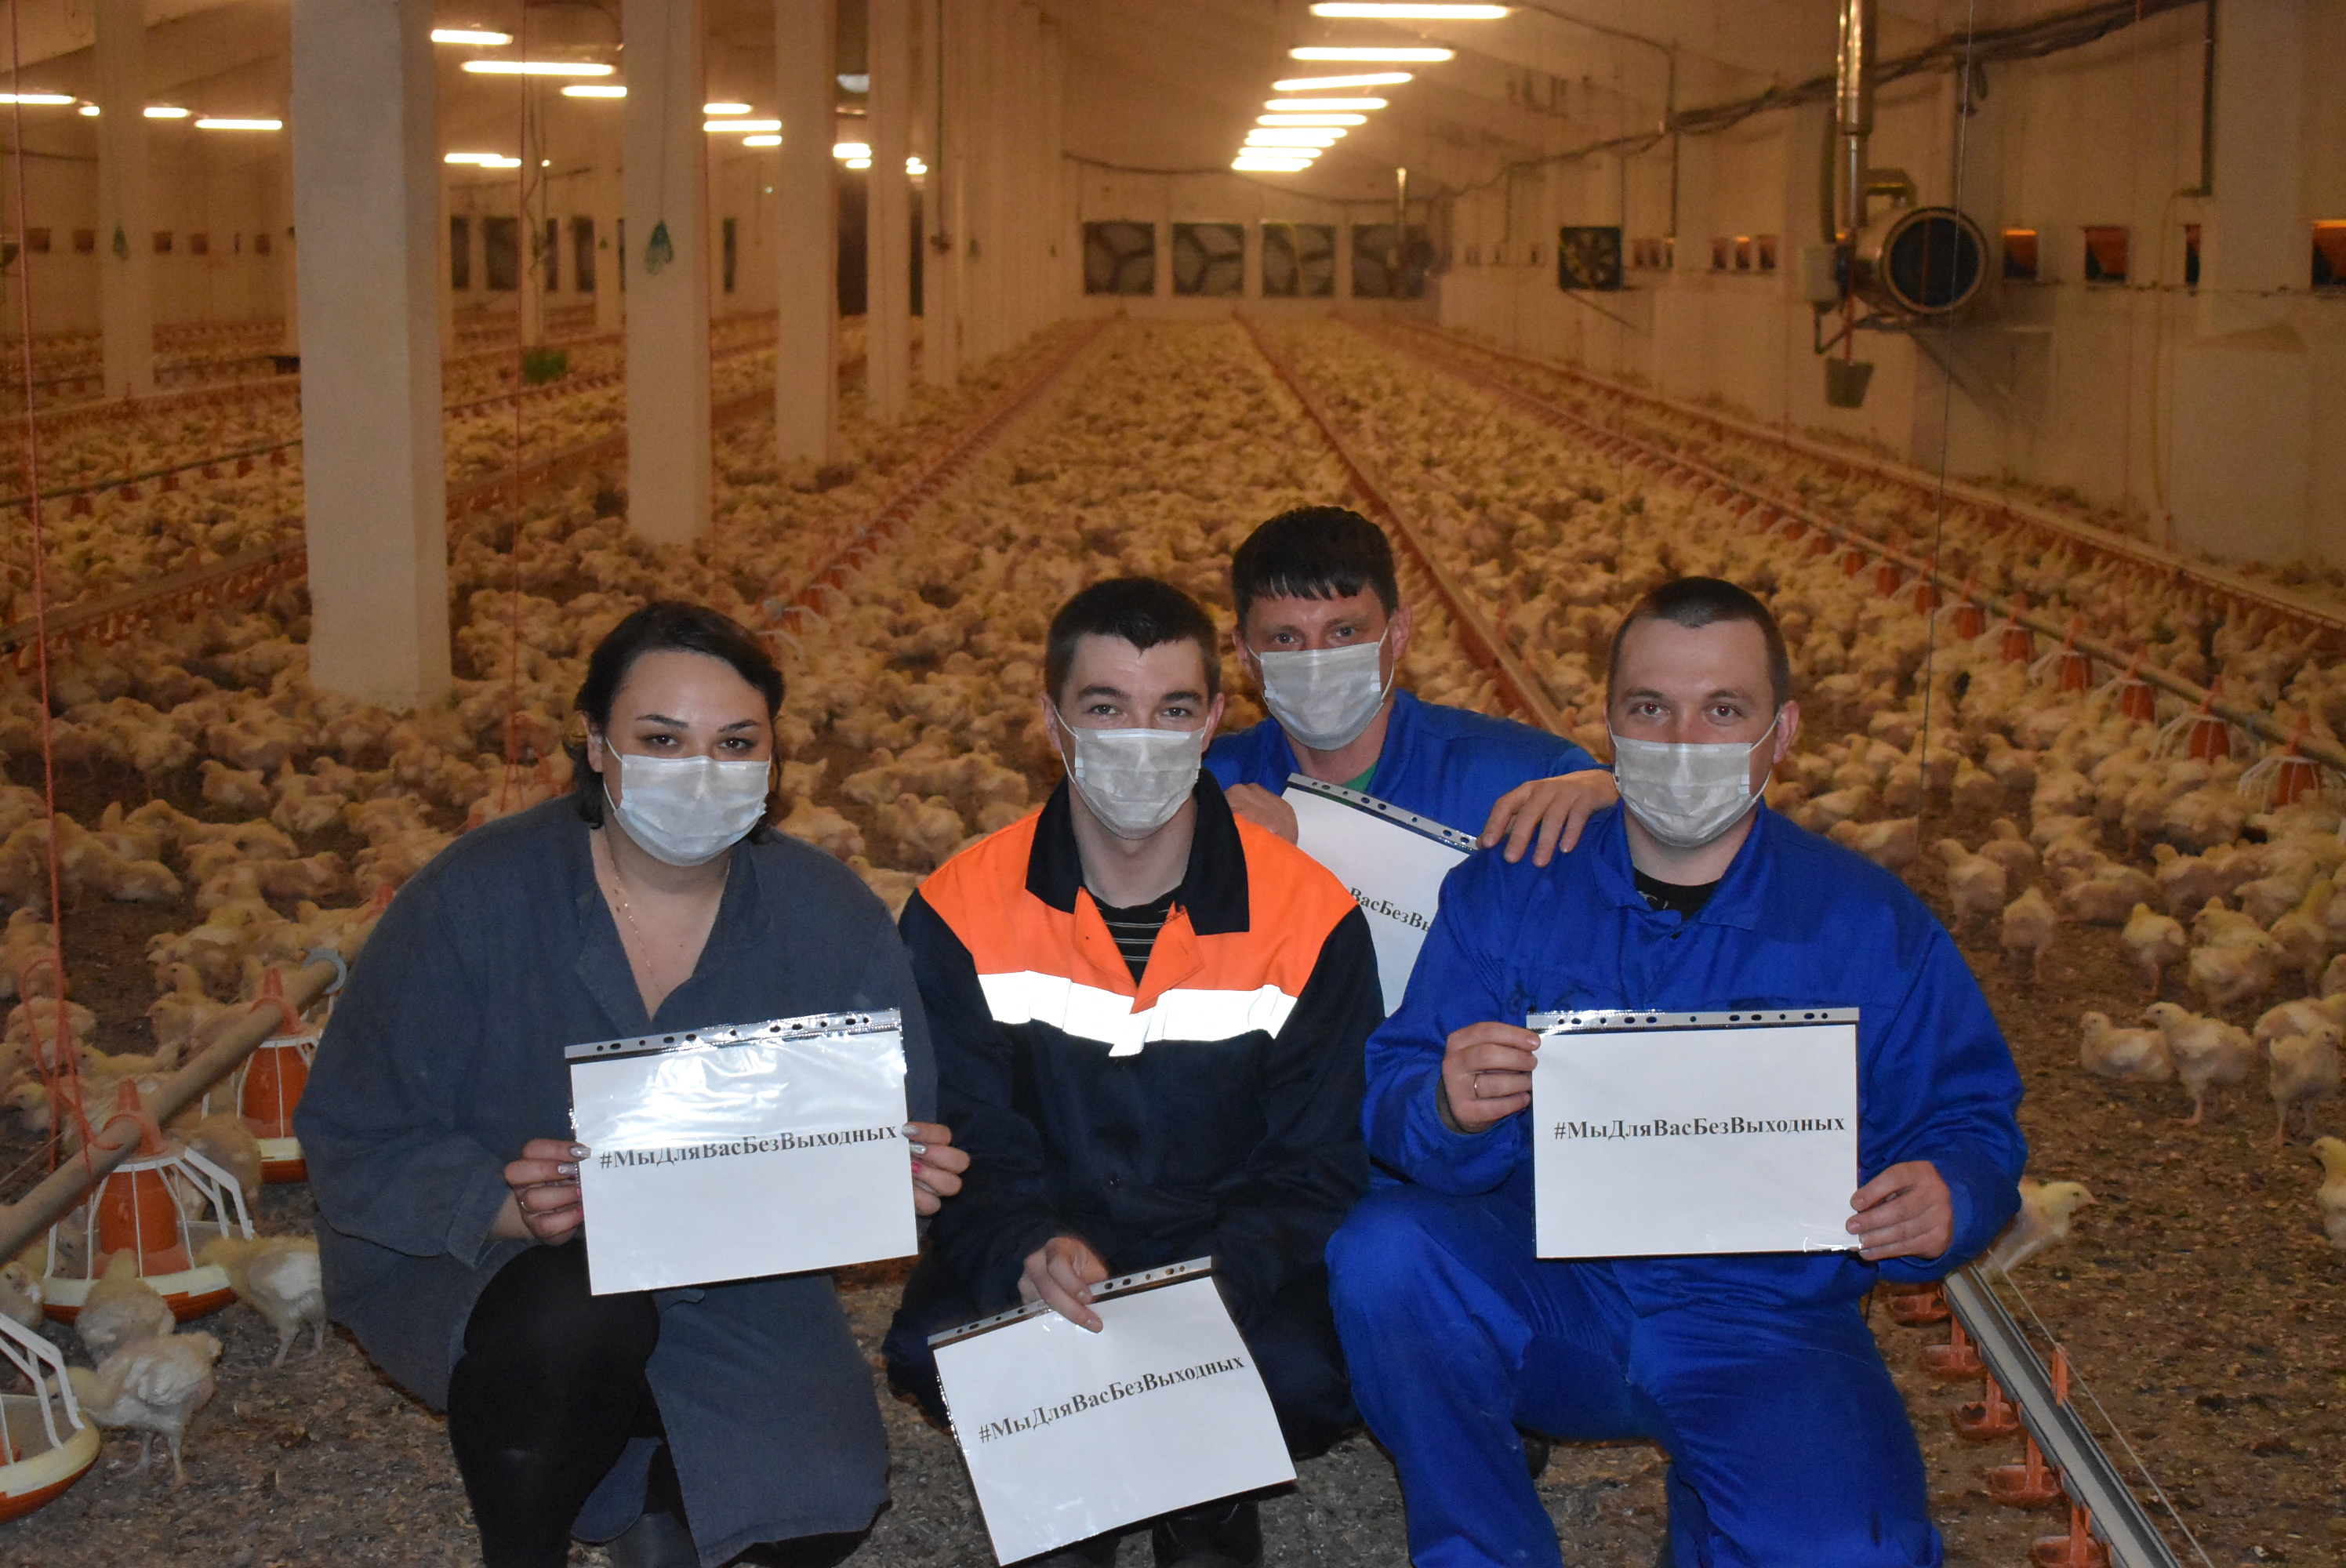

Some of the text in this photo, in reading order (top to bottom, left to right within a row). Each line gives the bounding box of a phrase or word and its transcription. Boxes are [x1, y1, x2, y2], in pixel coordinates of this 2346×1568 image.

[600, 1127, 897, 1169] #МыДляВасБезВыходных
[1554, 1116, 1845, 1140] #МыДляВасБезВыходных
[979, 1357, 1245, 1443] #МыДляВасБезВыходных
